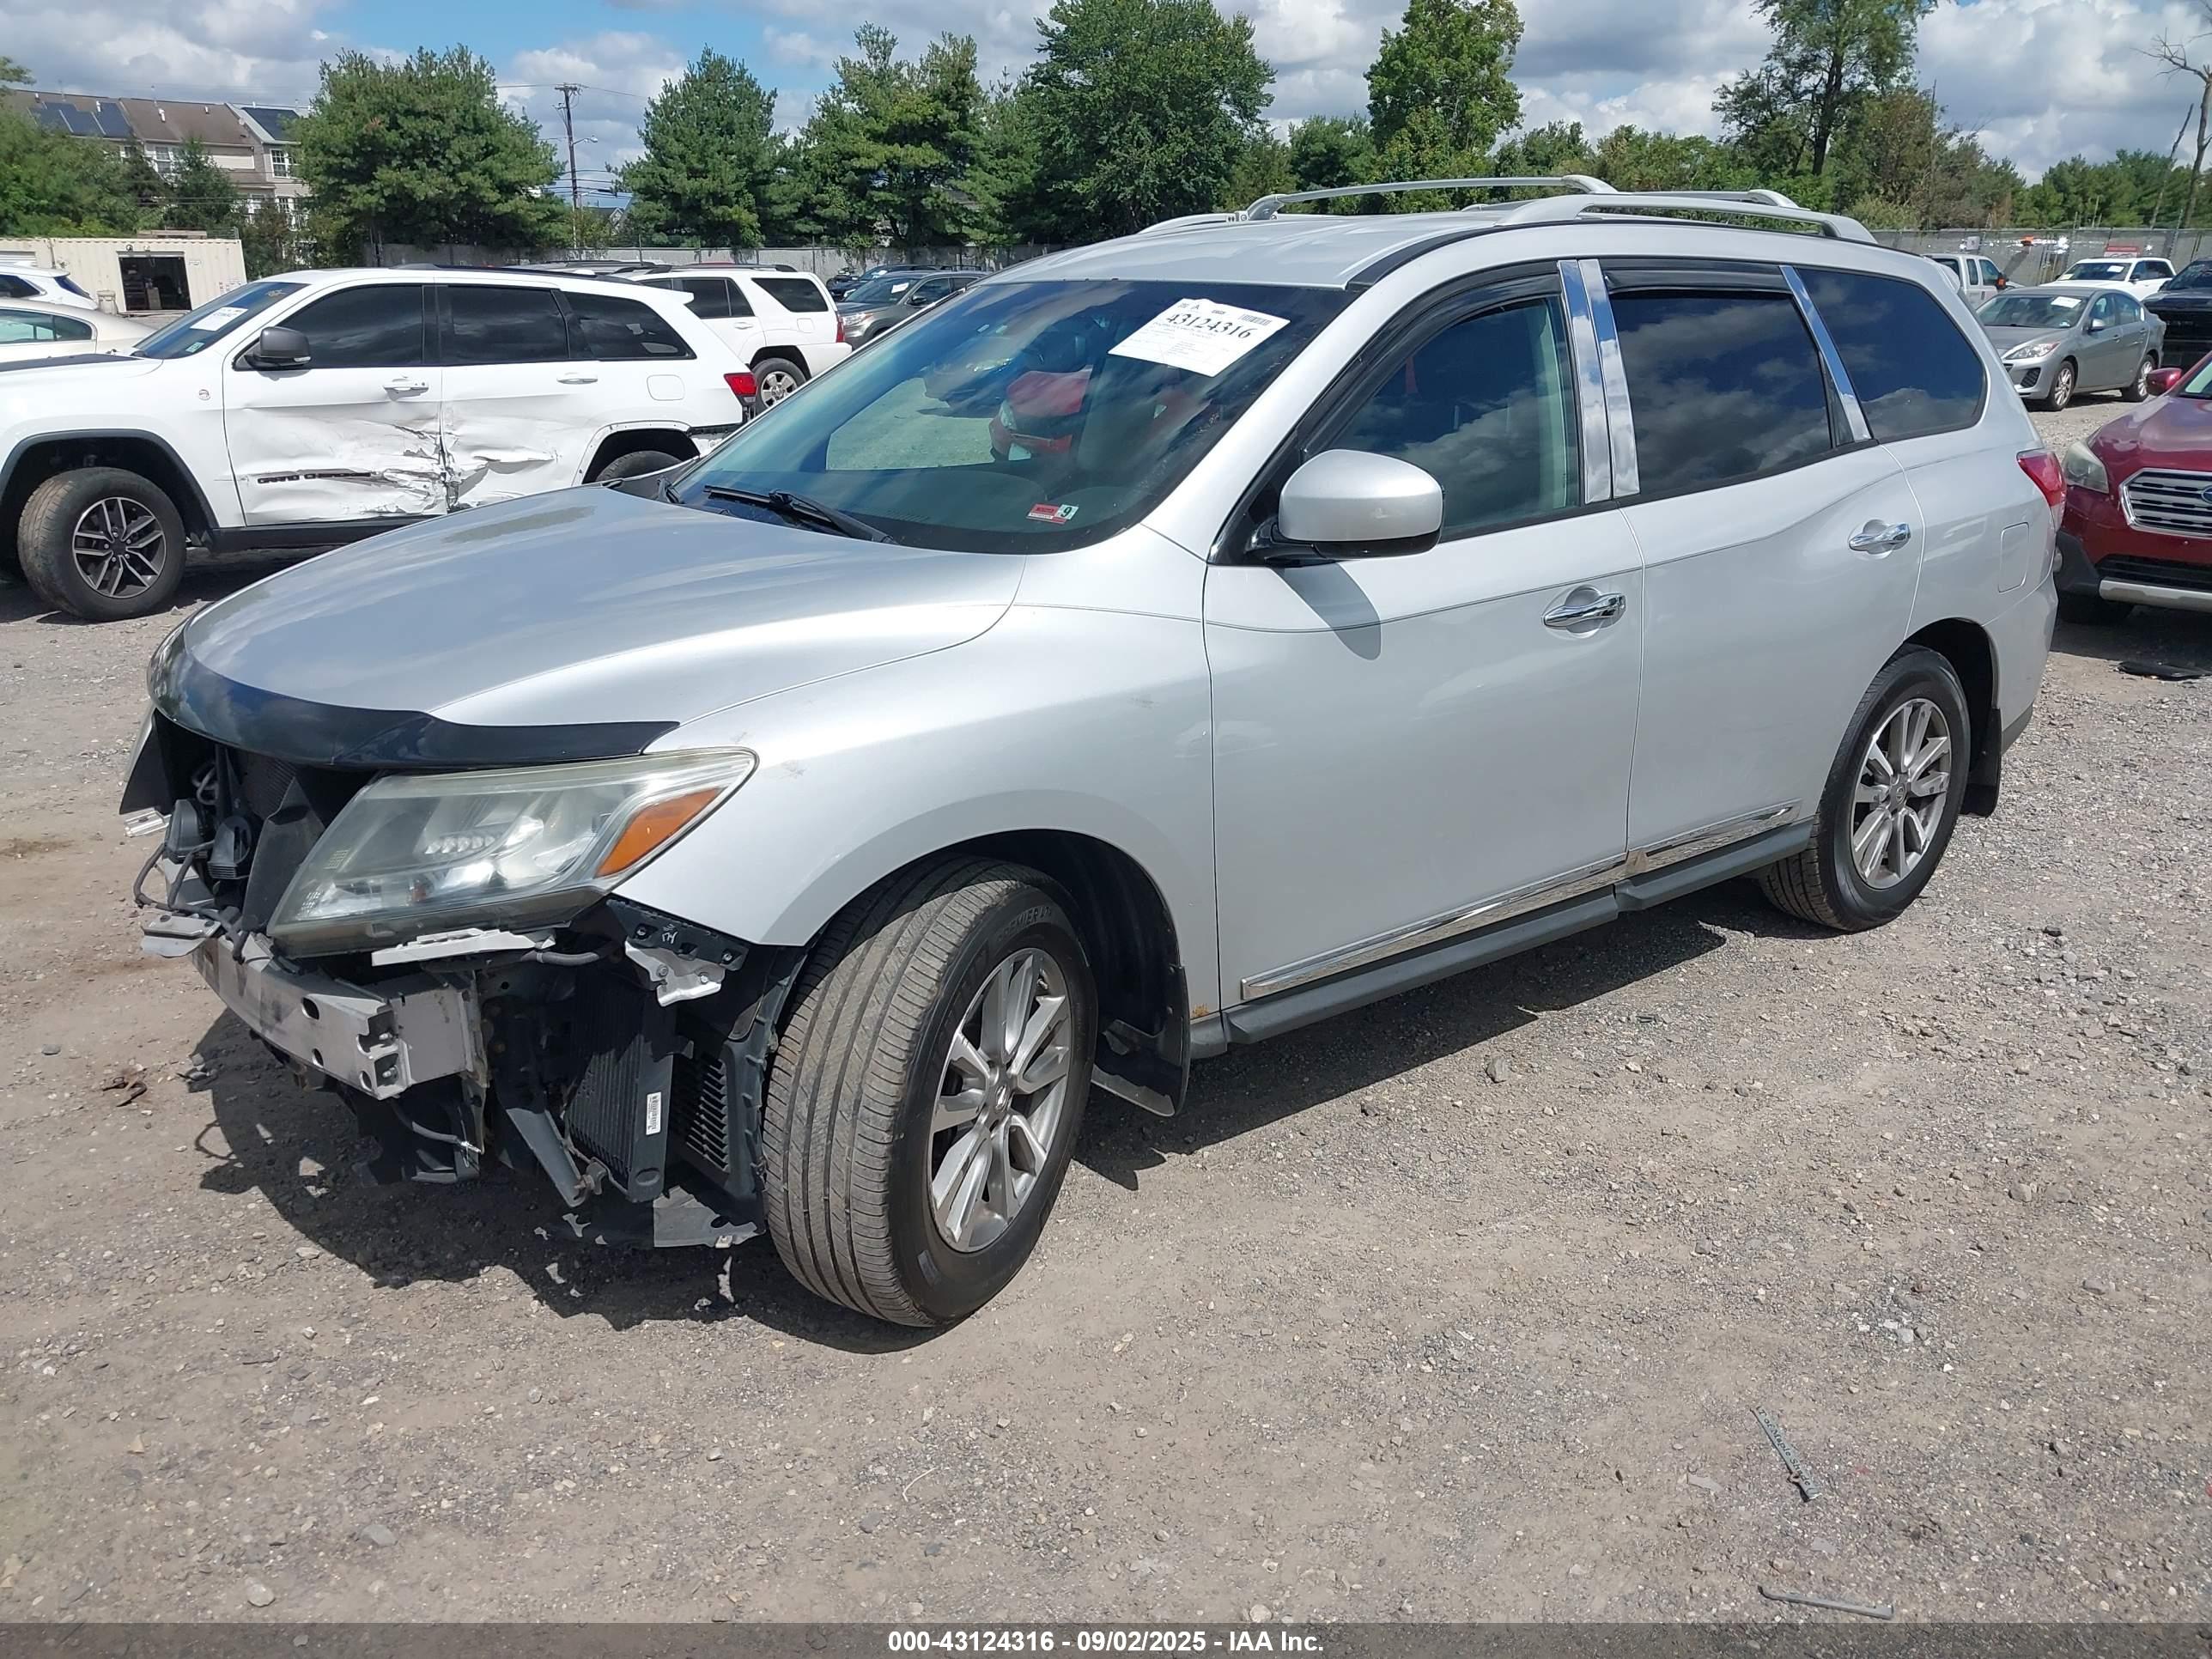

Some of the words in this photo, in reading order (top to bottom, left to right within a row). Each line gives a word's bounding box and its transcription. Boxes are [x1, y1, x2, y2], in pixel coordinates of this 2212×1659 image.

[1166, 313, 1258, 338] 43124316
[1060, 506, 1073, 518] 9
[1771, 1429, 1791, 1456] Maple
[1790, 1458, 1811, 1486] Shade
